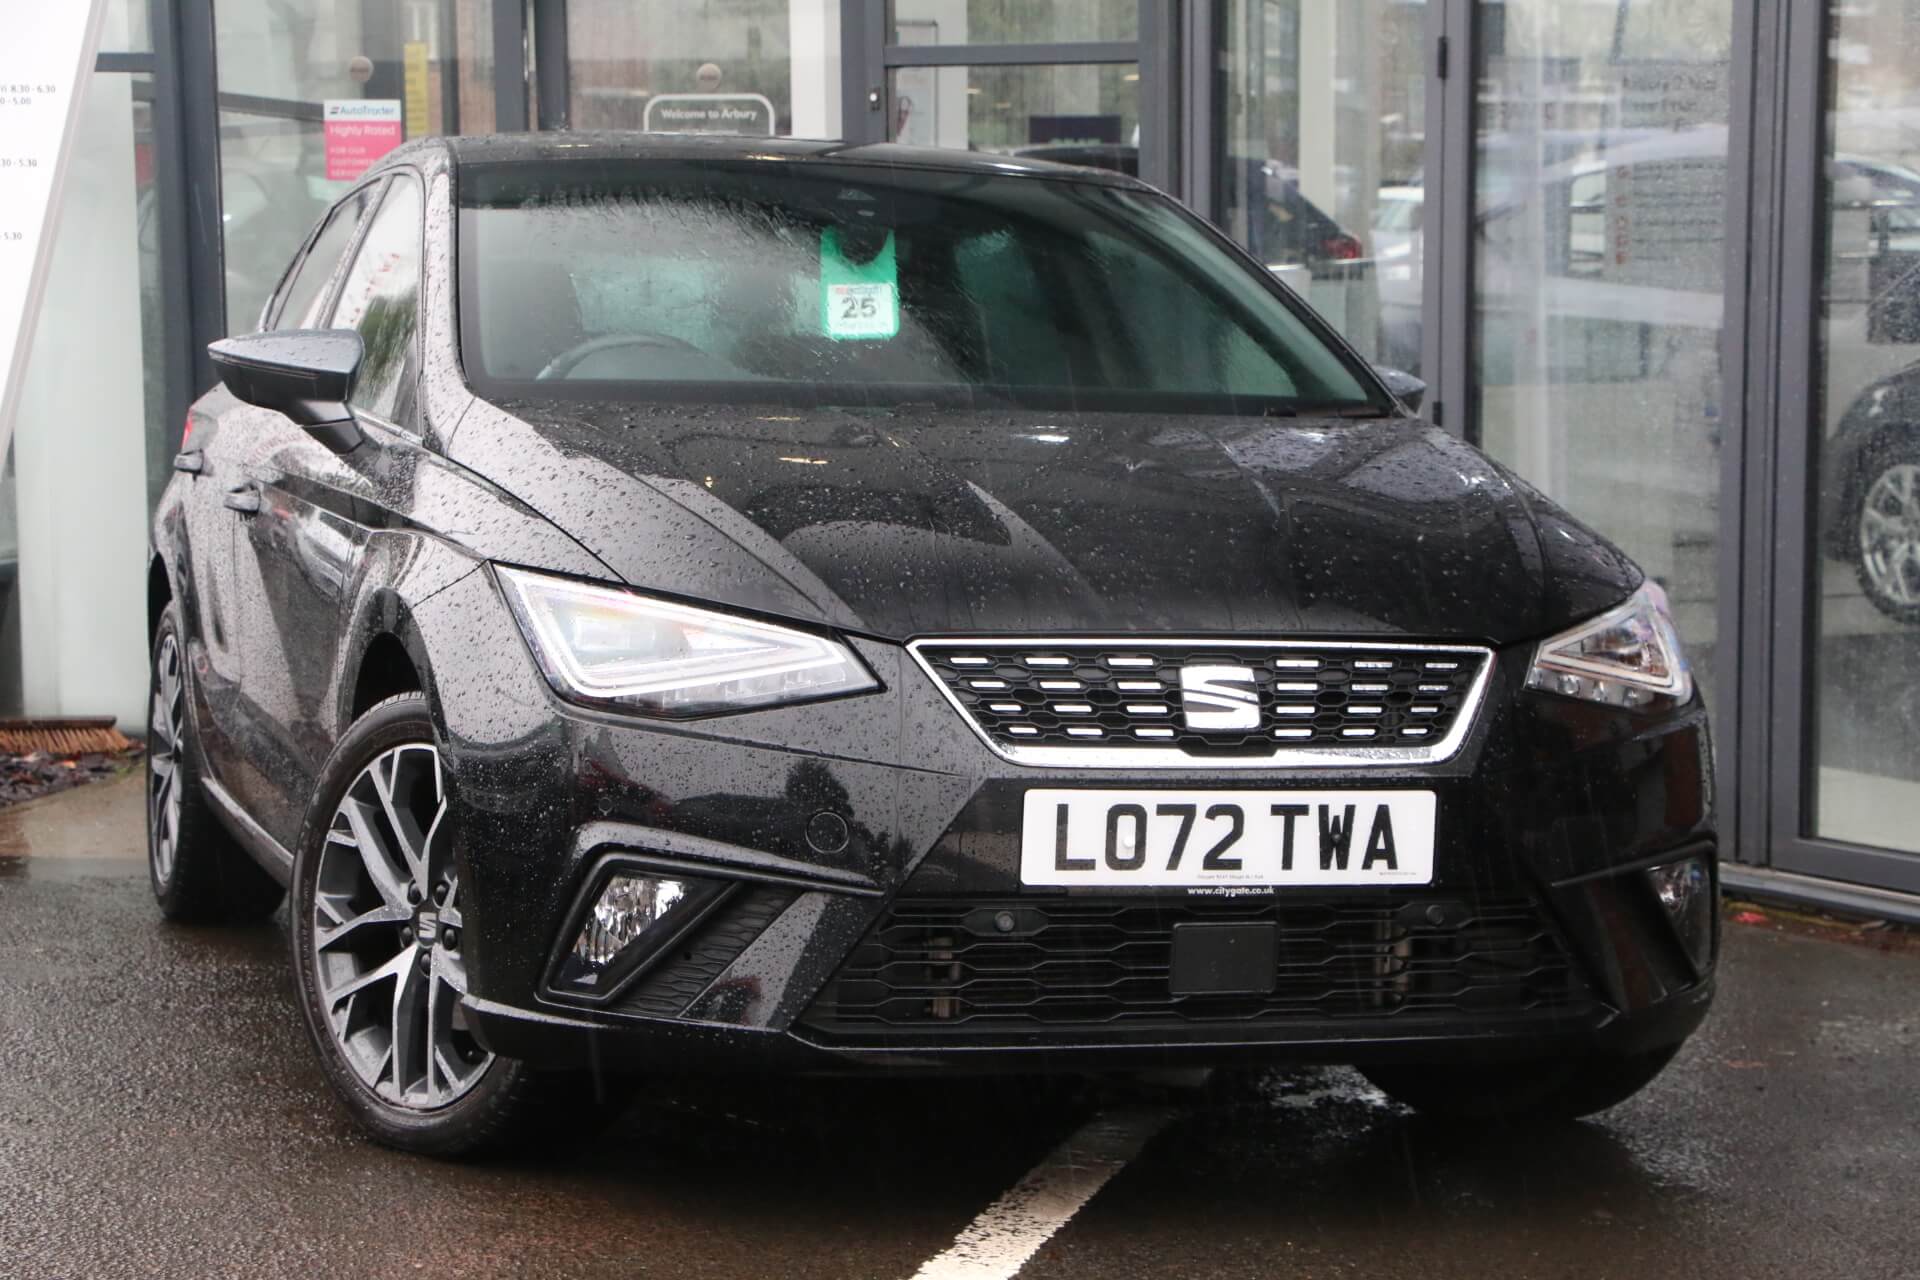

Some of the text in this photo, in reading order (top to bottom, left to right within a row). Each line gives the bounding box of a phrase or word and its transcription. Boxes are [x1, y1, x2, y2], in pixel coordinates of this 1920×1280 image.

[10, 84, 30, 94] 8.30
[37, 84, 56, 94] 6.30
[13, 96, 31, 106] 5.00
[661, 108, 757, 121] Welcome to Arbury
[329, 125, 396, 138] Highly Rated
[19, 158, 37, 168] 5.30
[4, 232, 22, 242] 5.30
[840, 296, 877, 319] 25
[1054, 802, 1399, 872] LO72 TWA
[1187, 886, 1274, 898] www.citygate.co.uk
